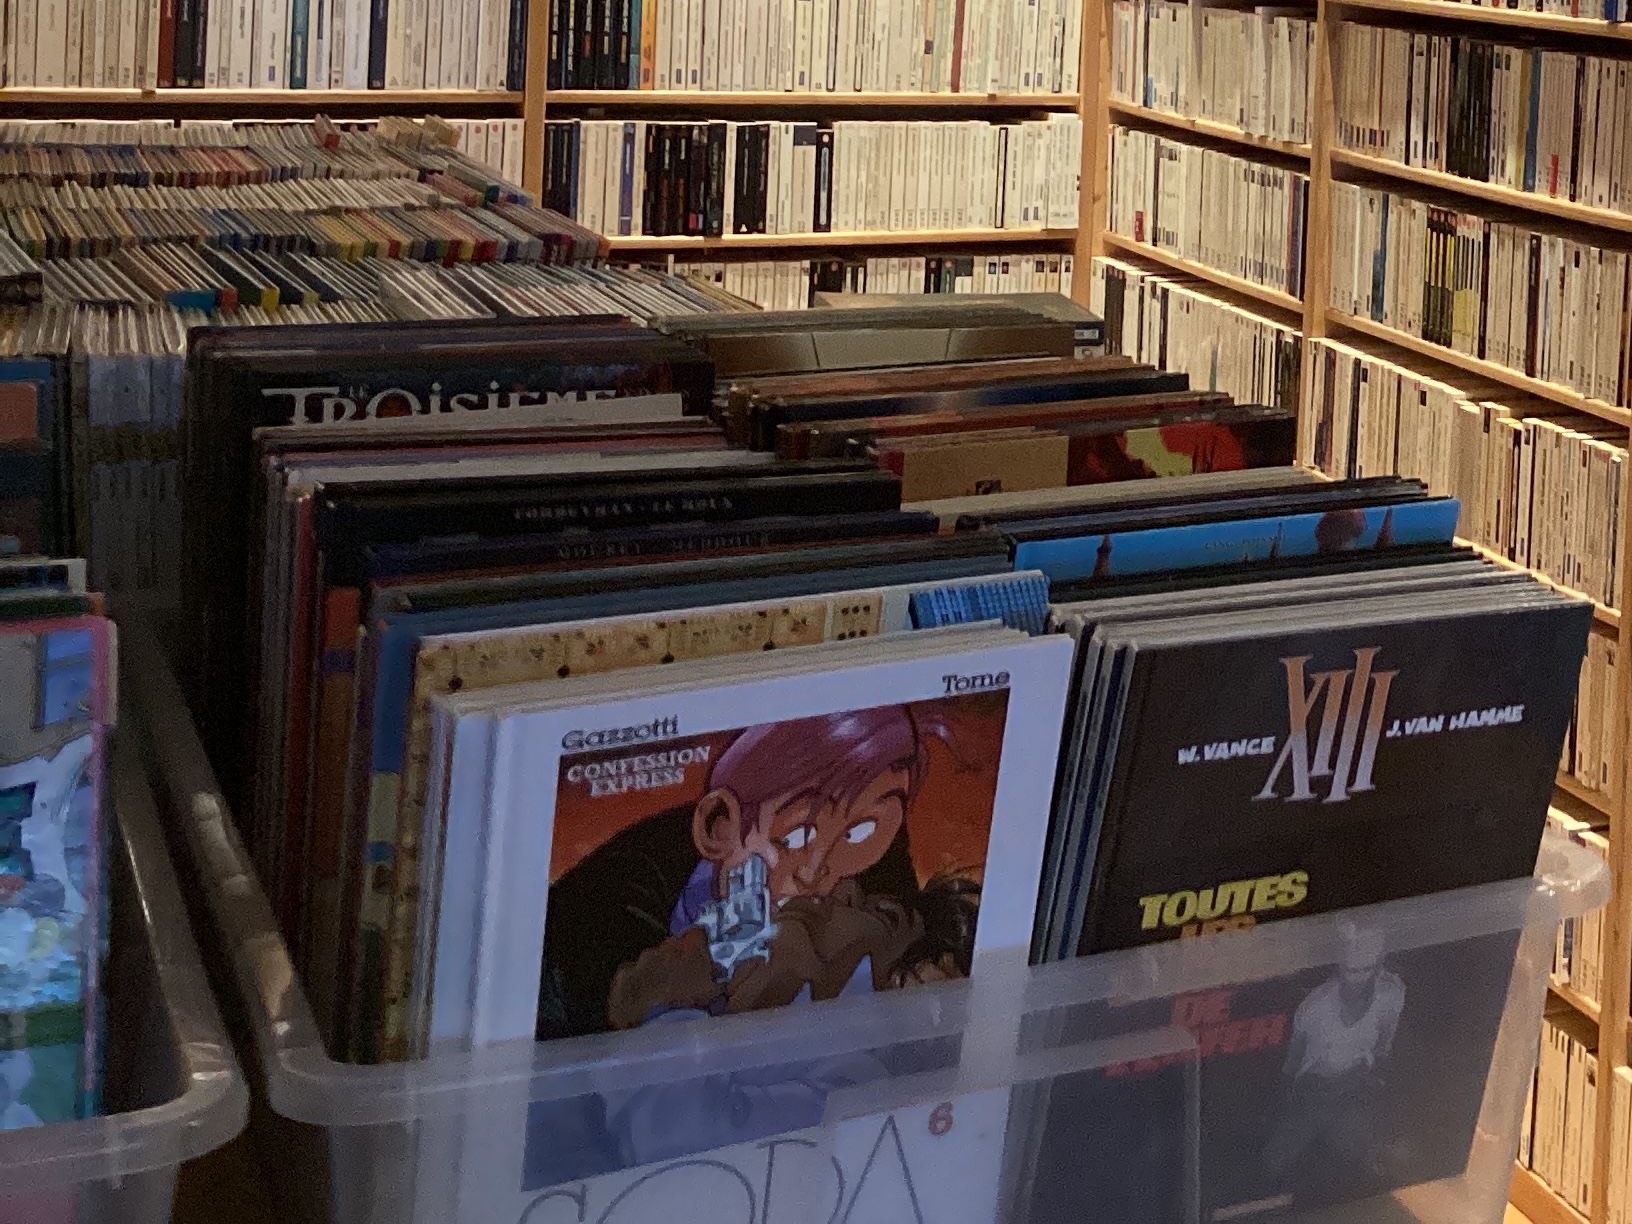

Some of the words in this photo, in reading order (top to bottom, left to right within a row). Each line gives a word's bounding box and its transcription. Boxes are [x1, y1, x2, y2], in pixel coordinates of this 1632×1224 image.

[942, 669, 1011, 694] Tome
[561, 714, 680, 752] Gazzotti
[1251, 645, 1400, 804] XIII
[1449, 704, 1525, 731] HAMME
[566, 745, 711, 783] CONFESSION
[588, 766, 686, 799] EXPRESS
[1140, 870, 1311, 931] TOUTES
[928, 1101, 954, 1138] 6
